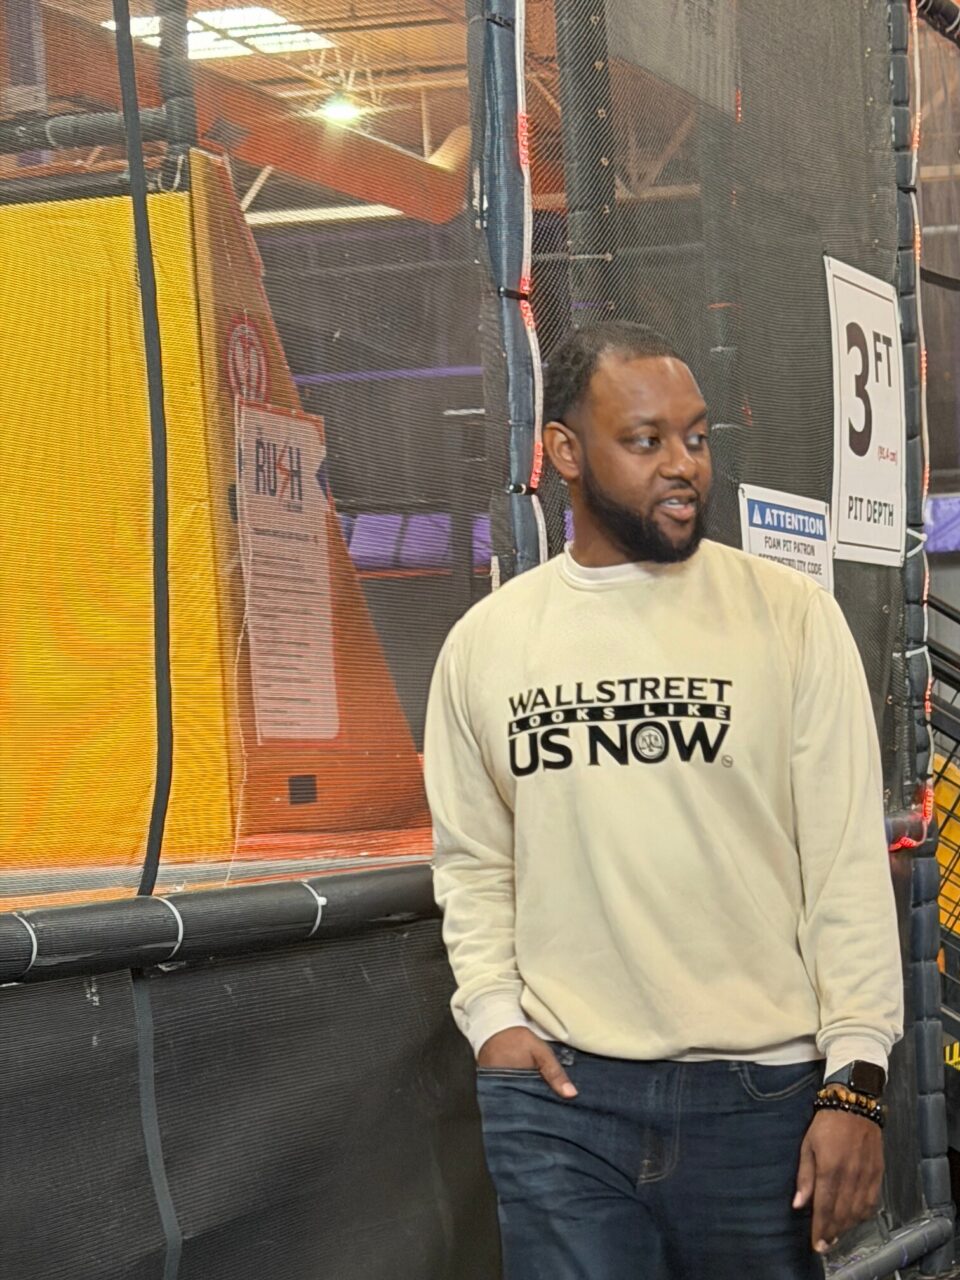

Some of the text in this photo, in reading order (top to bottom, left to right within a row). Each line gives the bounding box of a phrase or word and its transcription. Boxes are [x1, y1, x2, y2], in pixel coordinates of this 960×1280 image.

[845, 321, 893, 457] 3 FT
[764, 507, 824, 536] ATTENTION
[848, 496, 894, 526] PIT DEPTH
[764, 536, 815, 557] FOAM PIT PATRON
[807, 561, 823, 576] CODE
[511, 703, 728, 734] LOOKS LIKE
[508, 720, 731, 777] US NOW
